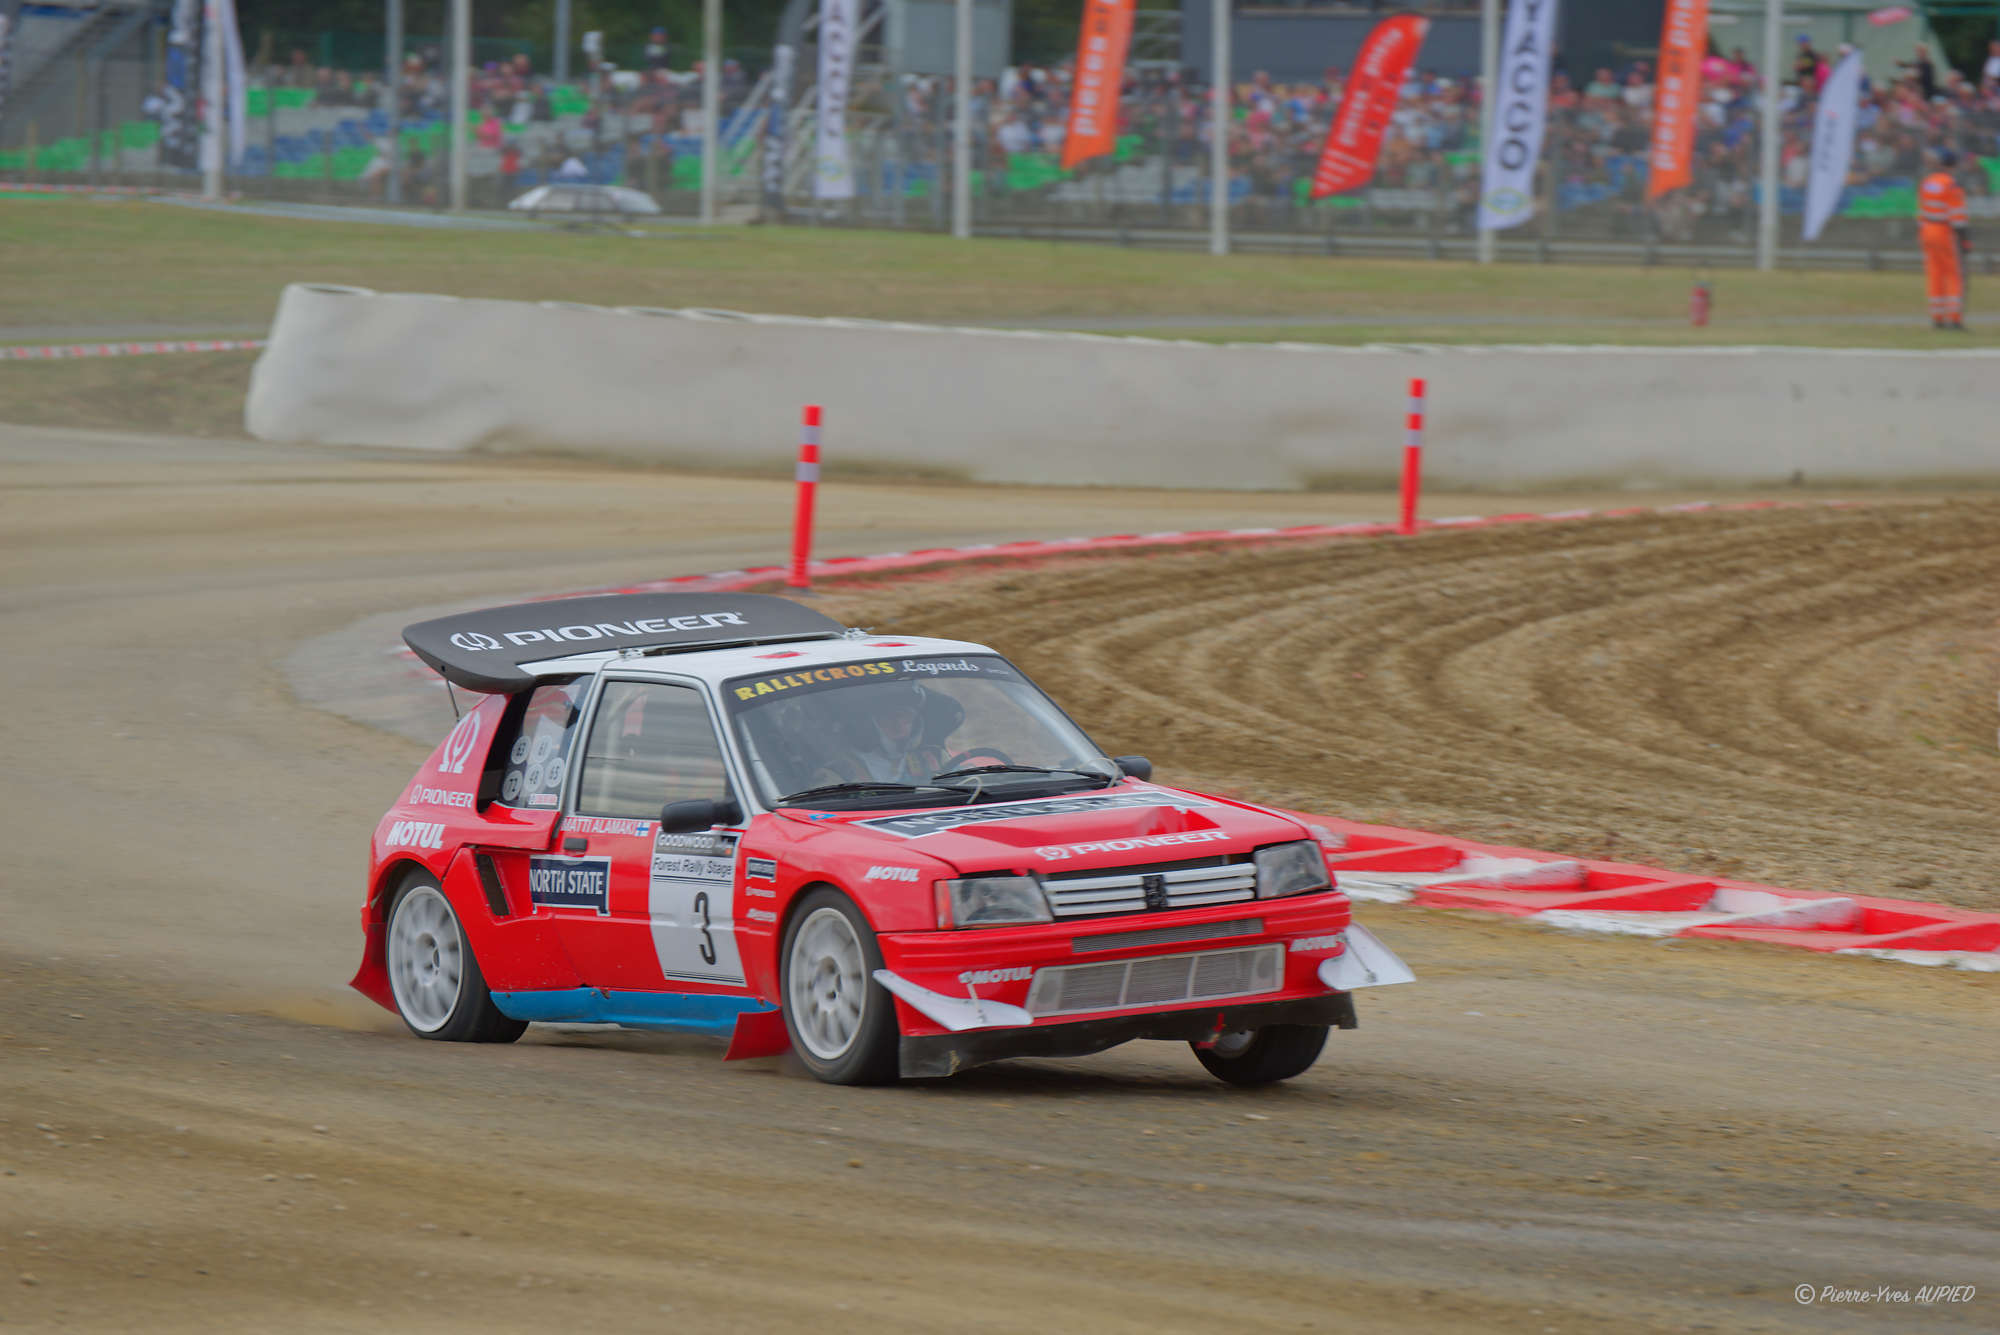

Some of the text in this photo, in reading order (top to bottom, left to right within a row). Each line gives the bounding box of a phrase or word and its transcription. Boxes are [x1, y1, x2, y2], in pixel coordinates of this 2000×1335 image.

[503, 612, 749, 646] PIONEER
[734, 660, 979, 701] RALLYCROSS Legends
[421, 788, 474, 808] PIONEER
[385, 821, 446, 849] MOTUL
[658, 834, 714, 849] GOODWOOD
[1071, 831, 1232, 855] PIONEER
[653, 857, 680, 872] Forest
[683, 859, 705, 876] Rally
[707, 860, 732, 878] Stage
[864, 866, 920, 881] MOTUL
[529, 869, 604, 895] NORTH STATE
[694, 891, 716, 965] 3
[973, 966, 1033, 984] MOTUL
